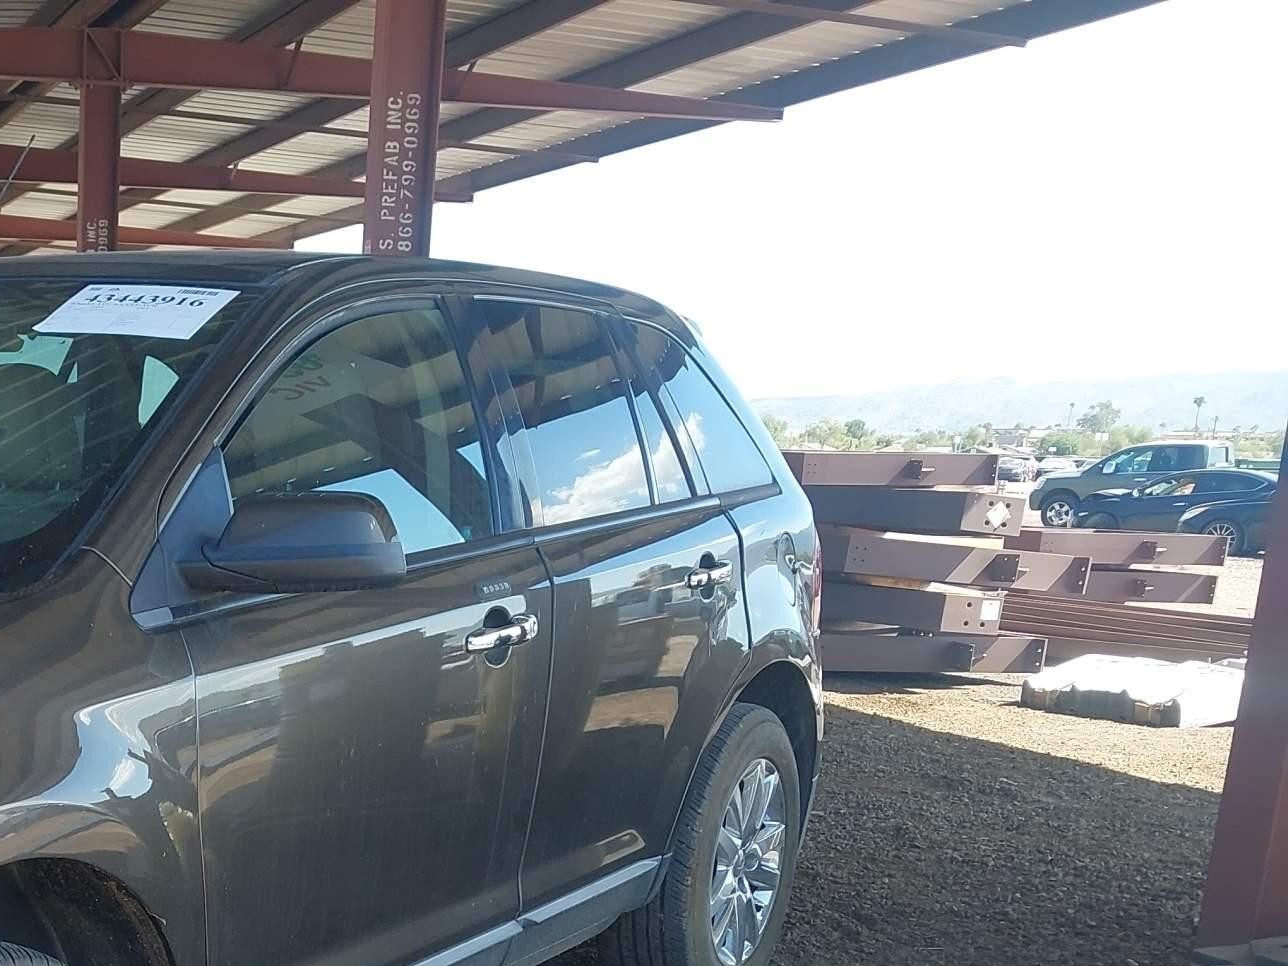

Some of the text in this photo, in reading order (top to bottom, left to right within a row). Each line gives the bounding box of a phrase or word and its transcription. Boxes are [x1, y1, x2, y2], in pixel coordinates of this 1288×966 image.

[379, 91, 403, 250] S. PREFAB INC.
[397, 93, 421, 251] 866-799-0969
[84, 293, 208, 308] 43443916
